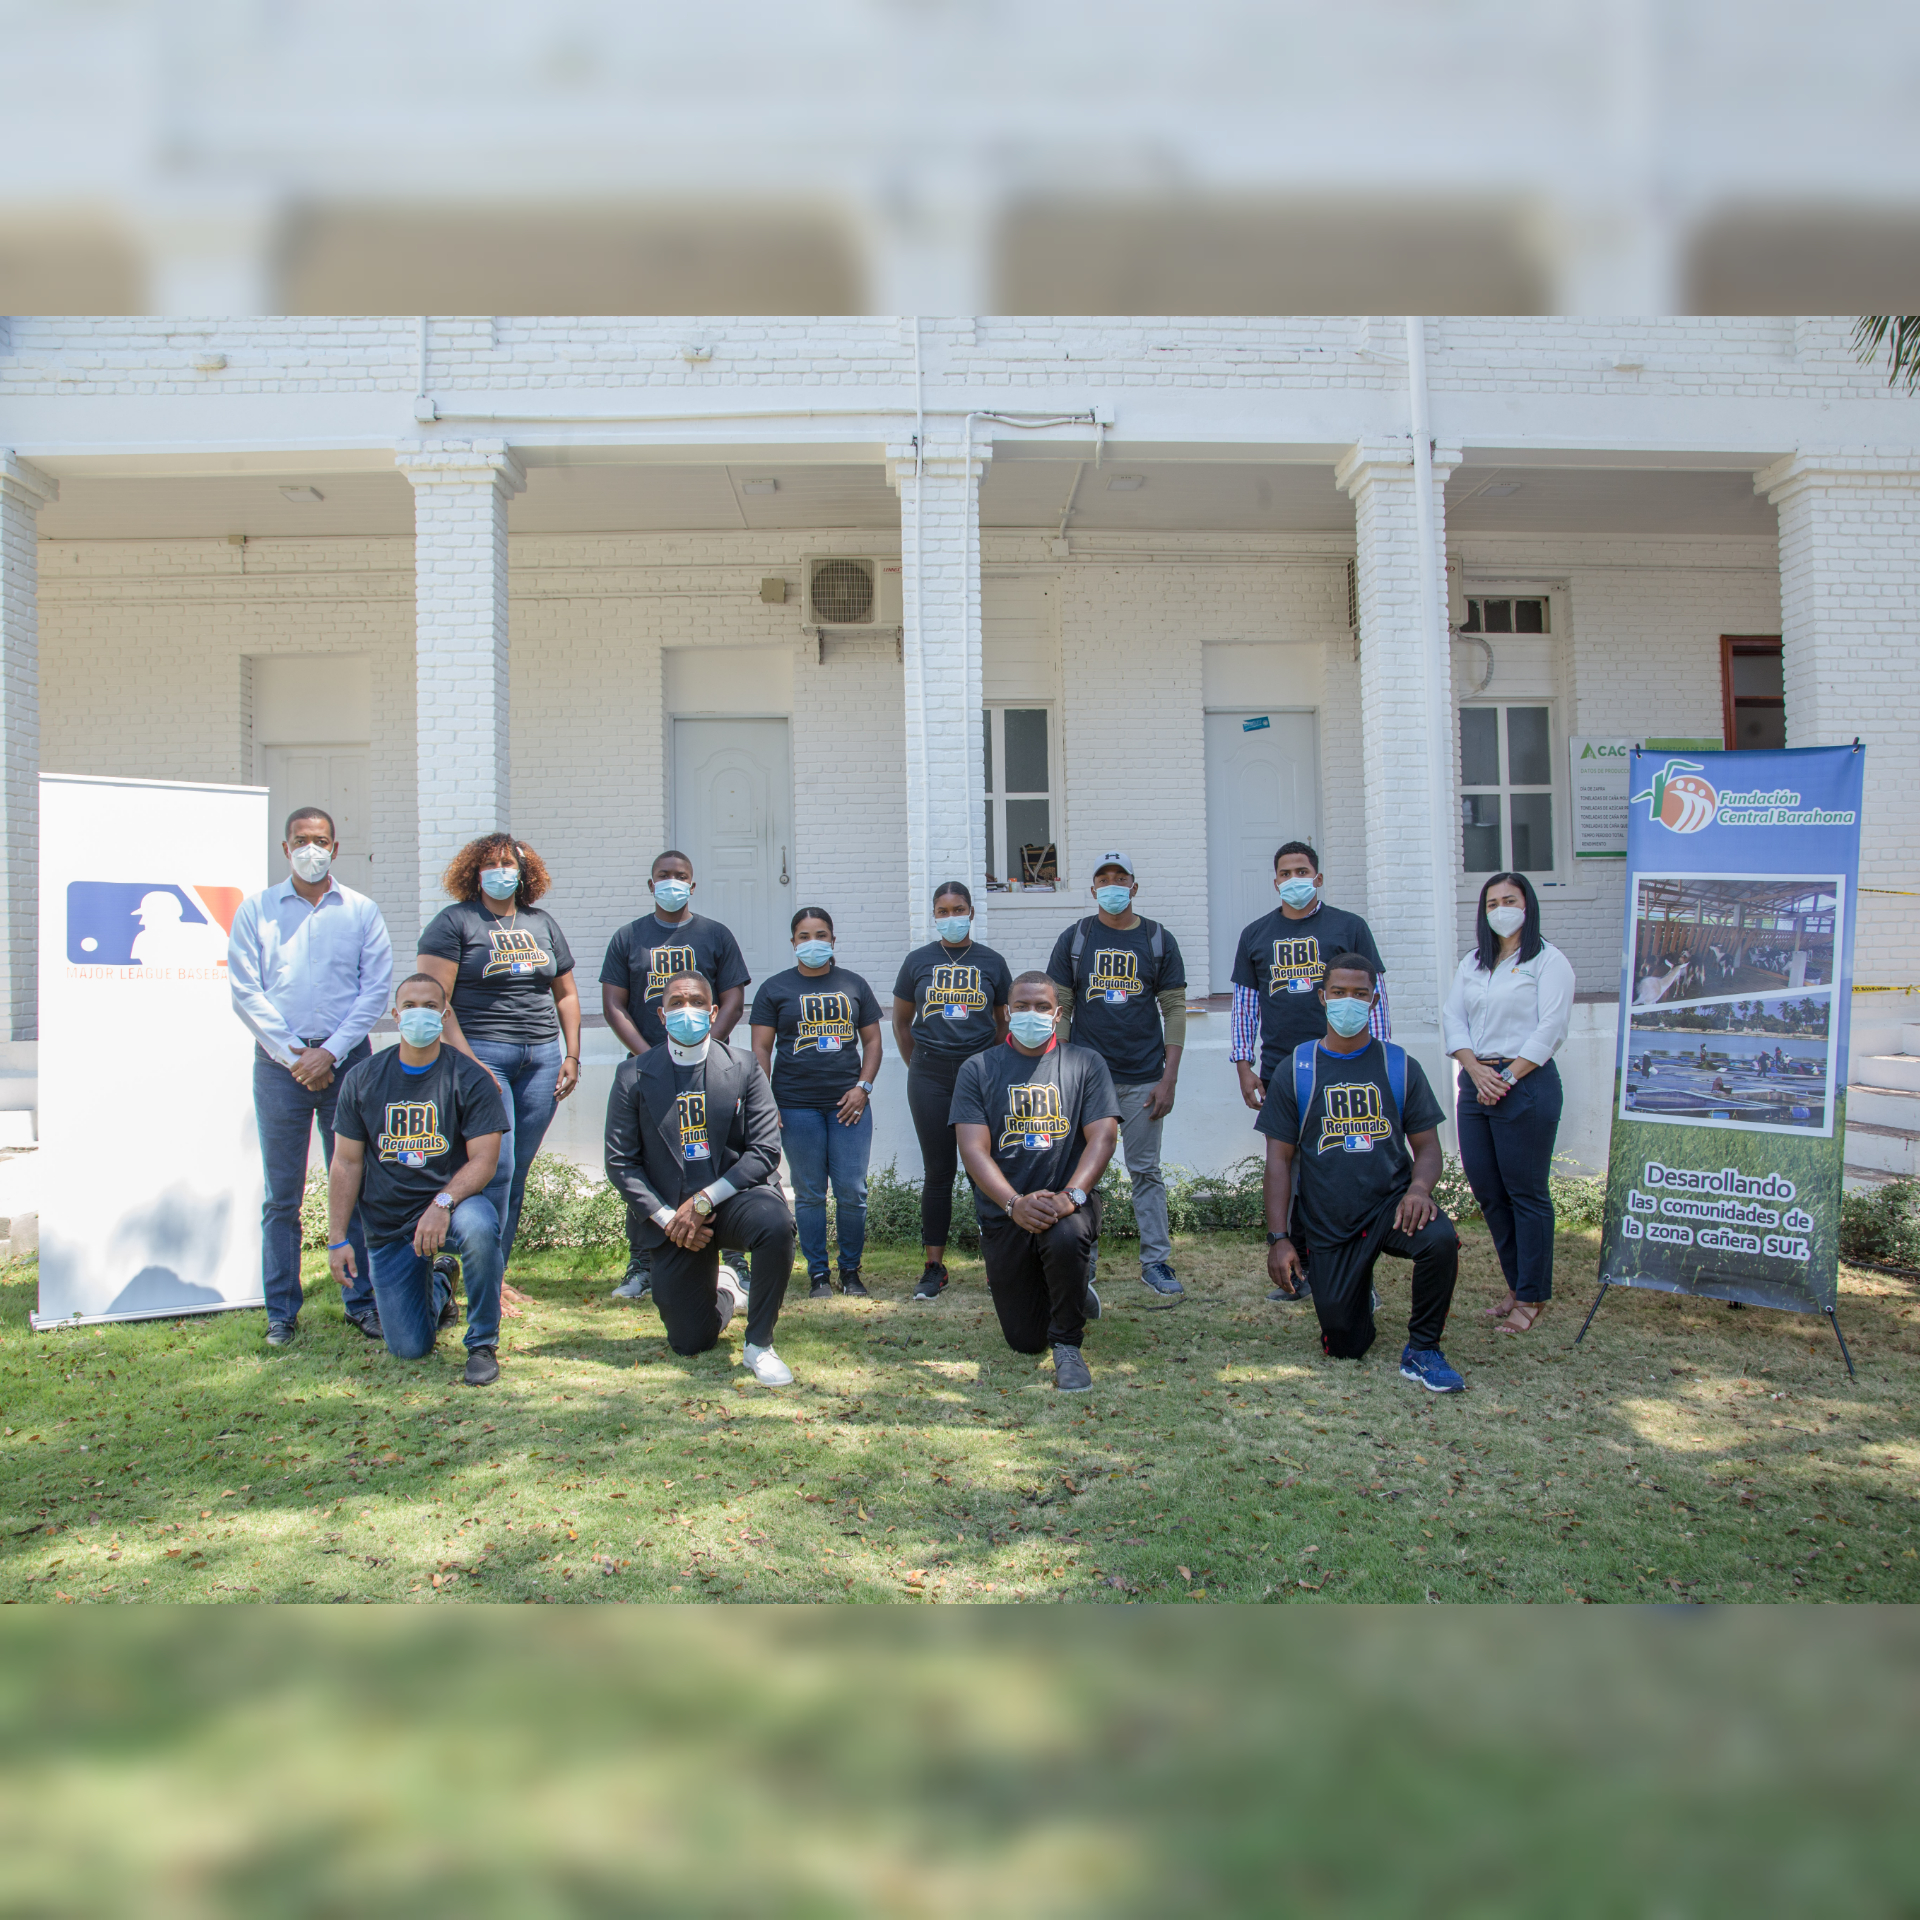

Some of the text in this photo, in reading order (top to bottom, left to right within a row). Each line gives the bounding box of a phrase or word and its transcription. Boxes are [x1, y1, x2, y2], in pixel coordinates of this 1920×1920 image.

[1597, 745, 1627, 757] CAC
[1719, 790, 1800, 806] Fundación
[1719, 808, 1854, 824] Central Barahona
[494, 932, 535, 951] RBI
[494, 951, 545, 963] Regionals
[654, 949, 692, 975] RBI
[1277, 940, 1316, 967] RBI
[66, 967, 114, 980] MAJOR
[120, 967, 172, 980] LEAGUE
[1098, 953, 1135, 978] RBI
[1273, 964, 1324, 979] Regionals
[938, 968, 978, 990] RBI
[1092, 976, 1139, 990] Regionals
[929, 990, 984, 1004] Regionals
[805, 995, 848, 1022] RBI
[801, 1023, 852, 1036] Regionals
[1013, 1088, 1057, 1118] RBI
[1330, 1088, 1378, 1119] RBI
[391, 1106, 433, 1137] RBI
[1008, 1117, 1067, 1133] Regionals
[1325, 1118, 1387, 1135] Regionals
[381, 1136, 443, 1151] Regionals
[1647, 1164, 1792, 1199] Desarollando
[1631, 1192, 1810, 1229] las comunidades de
[1625, 1218, 1807, 1257] la zona cañera sur.
